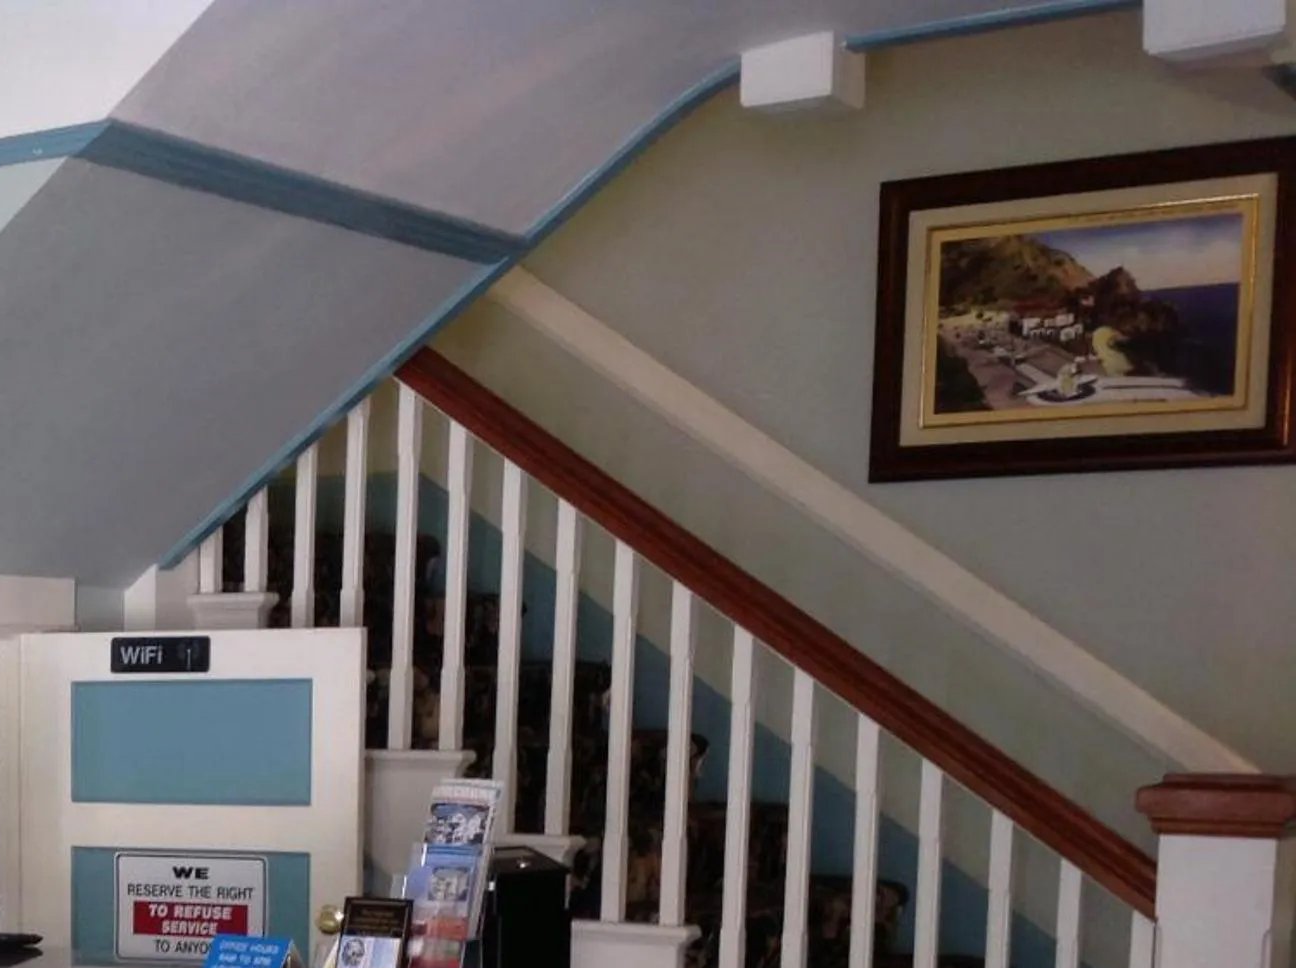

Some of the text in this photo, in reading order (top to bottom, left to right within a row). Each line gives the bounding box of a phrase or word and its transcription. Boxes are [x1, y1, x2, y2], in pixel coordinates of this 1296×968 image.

[120, 644, 163, 665] WiFi
[172, 866, 210, 880] WE
[127, 883, 255, 899] RESERVE THE RIGHT
[149, 904, 233, 920] TO REFUSE
[162, 920, 219, 936] SERVICE
[155, 939, 212, 955] TO ANYO
